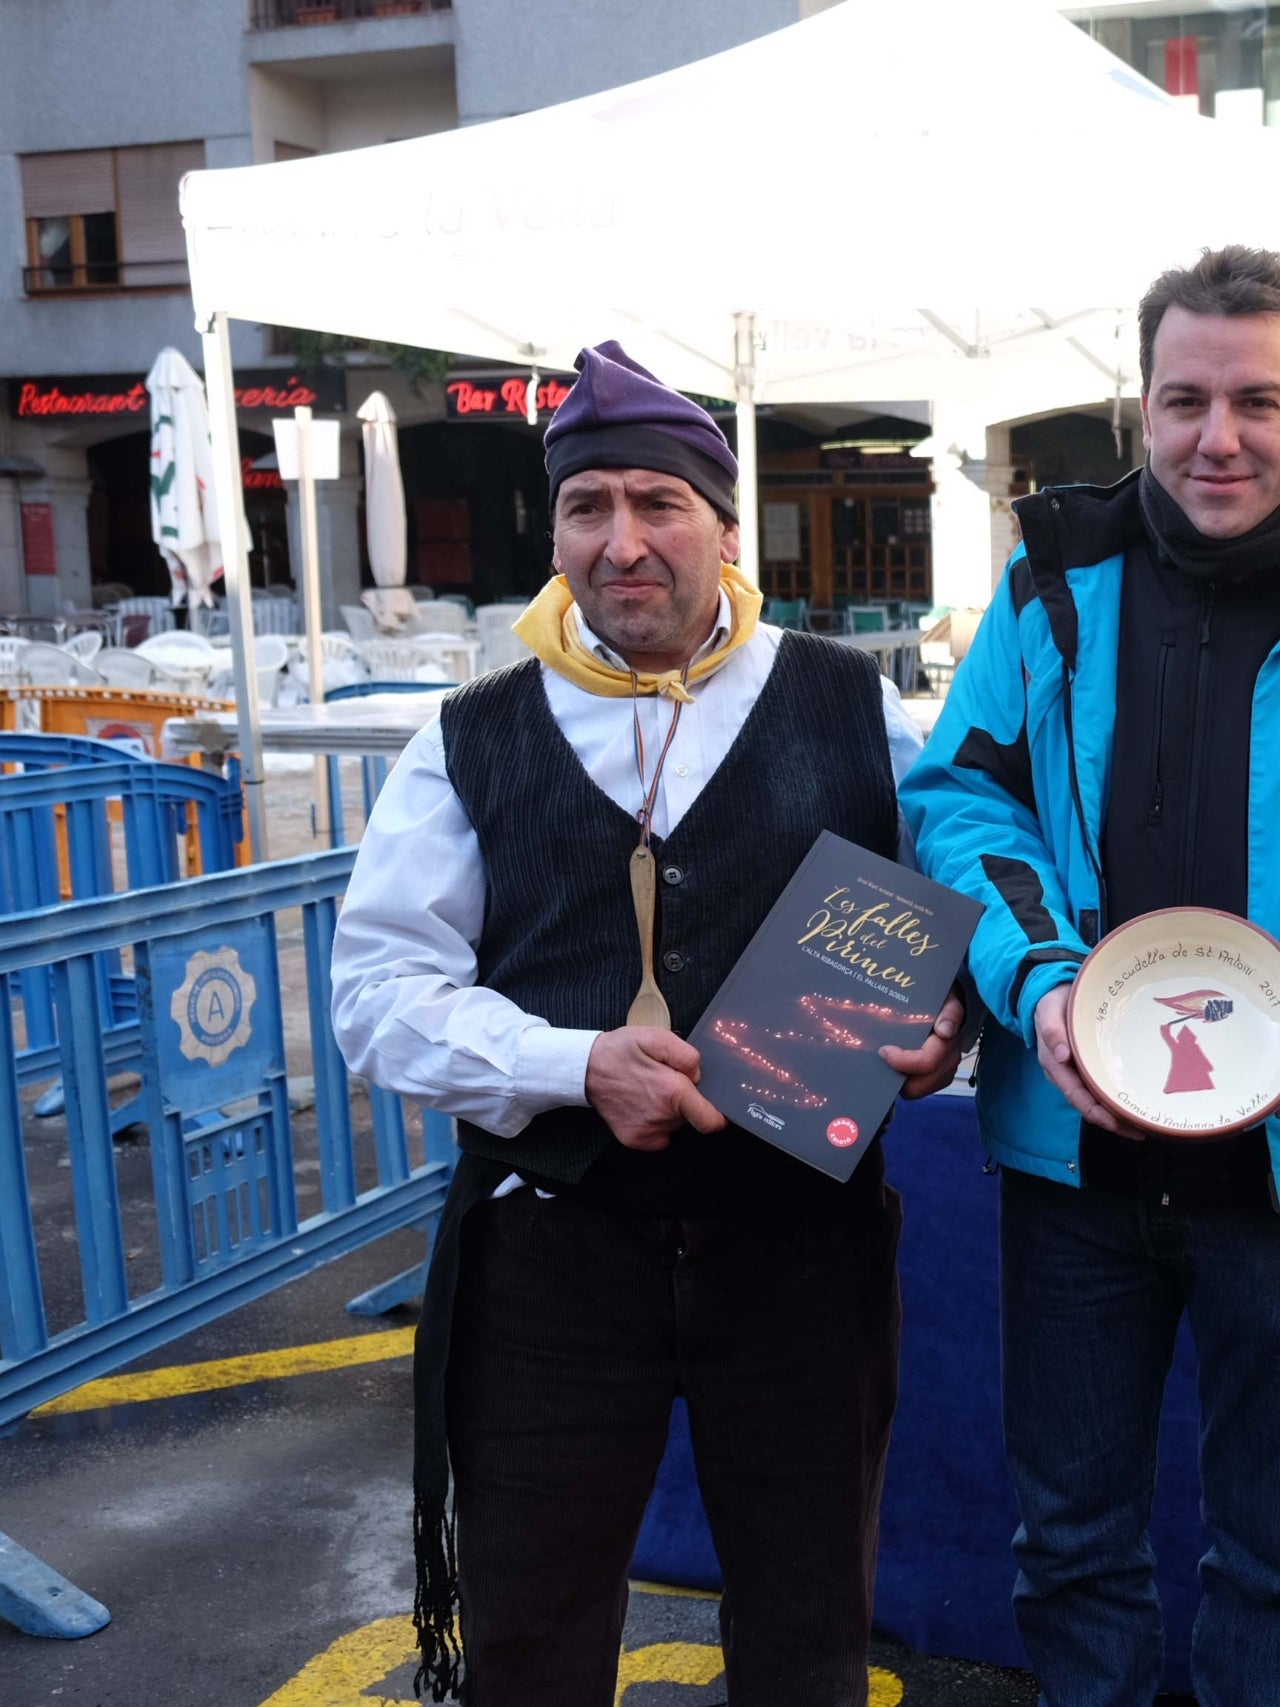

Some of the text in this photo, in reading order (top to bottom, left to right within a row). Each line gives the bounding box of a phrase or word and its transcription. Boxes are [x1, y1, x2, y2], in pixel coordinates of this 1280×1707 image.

[18, 382, 147, 416] Restaurant
[447, 380, 498, 415] Bar
[824, 885, 940, 956] Les falles
[797, 909, 916, 988] Pirineu
[860, 932, 888, 949] del
[1172, 942, 1188, 958] de
